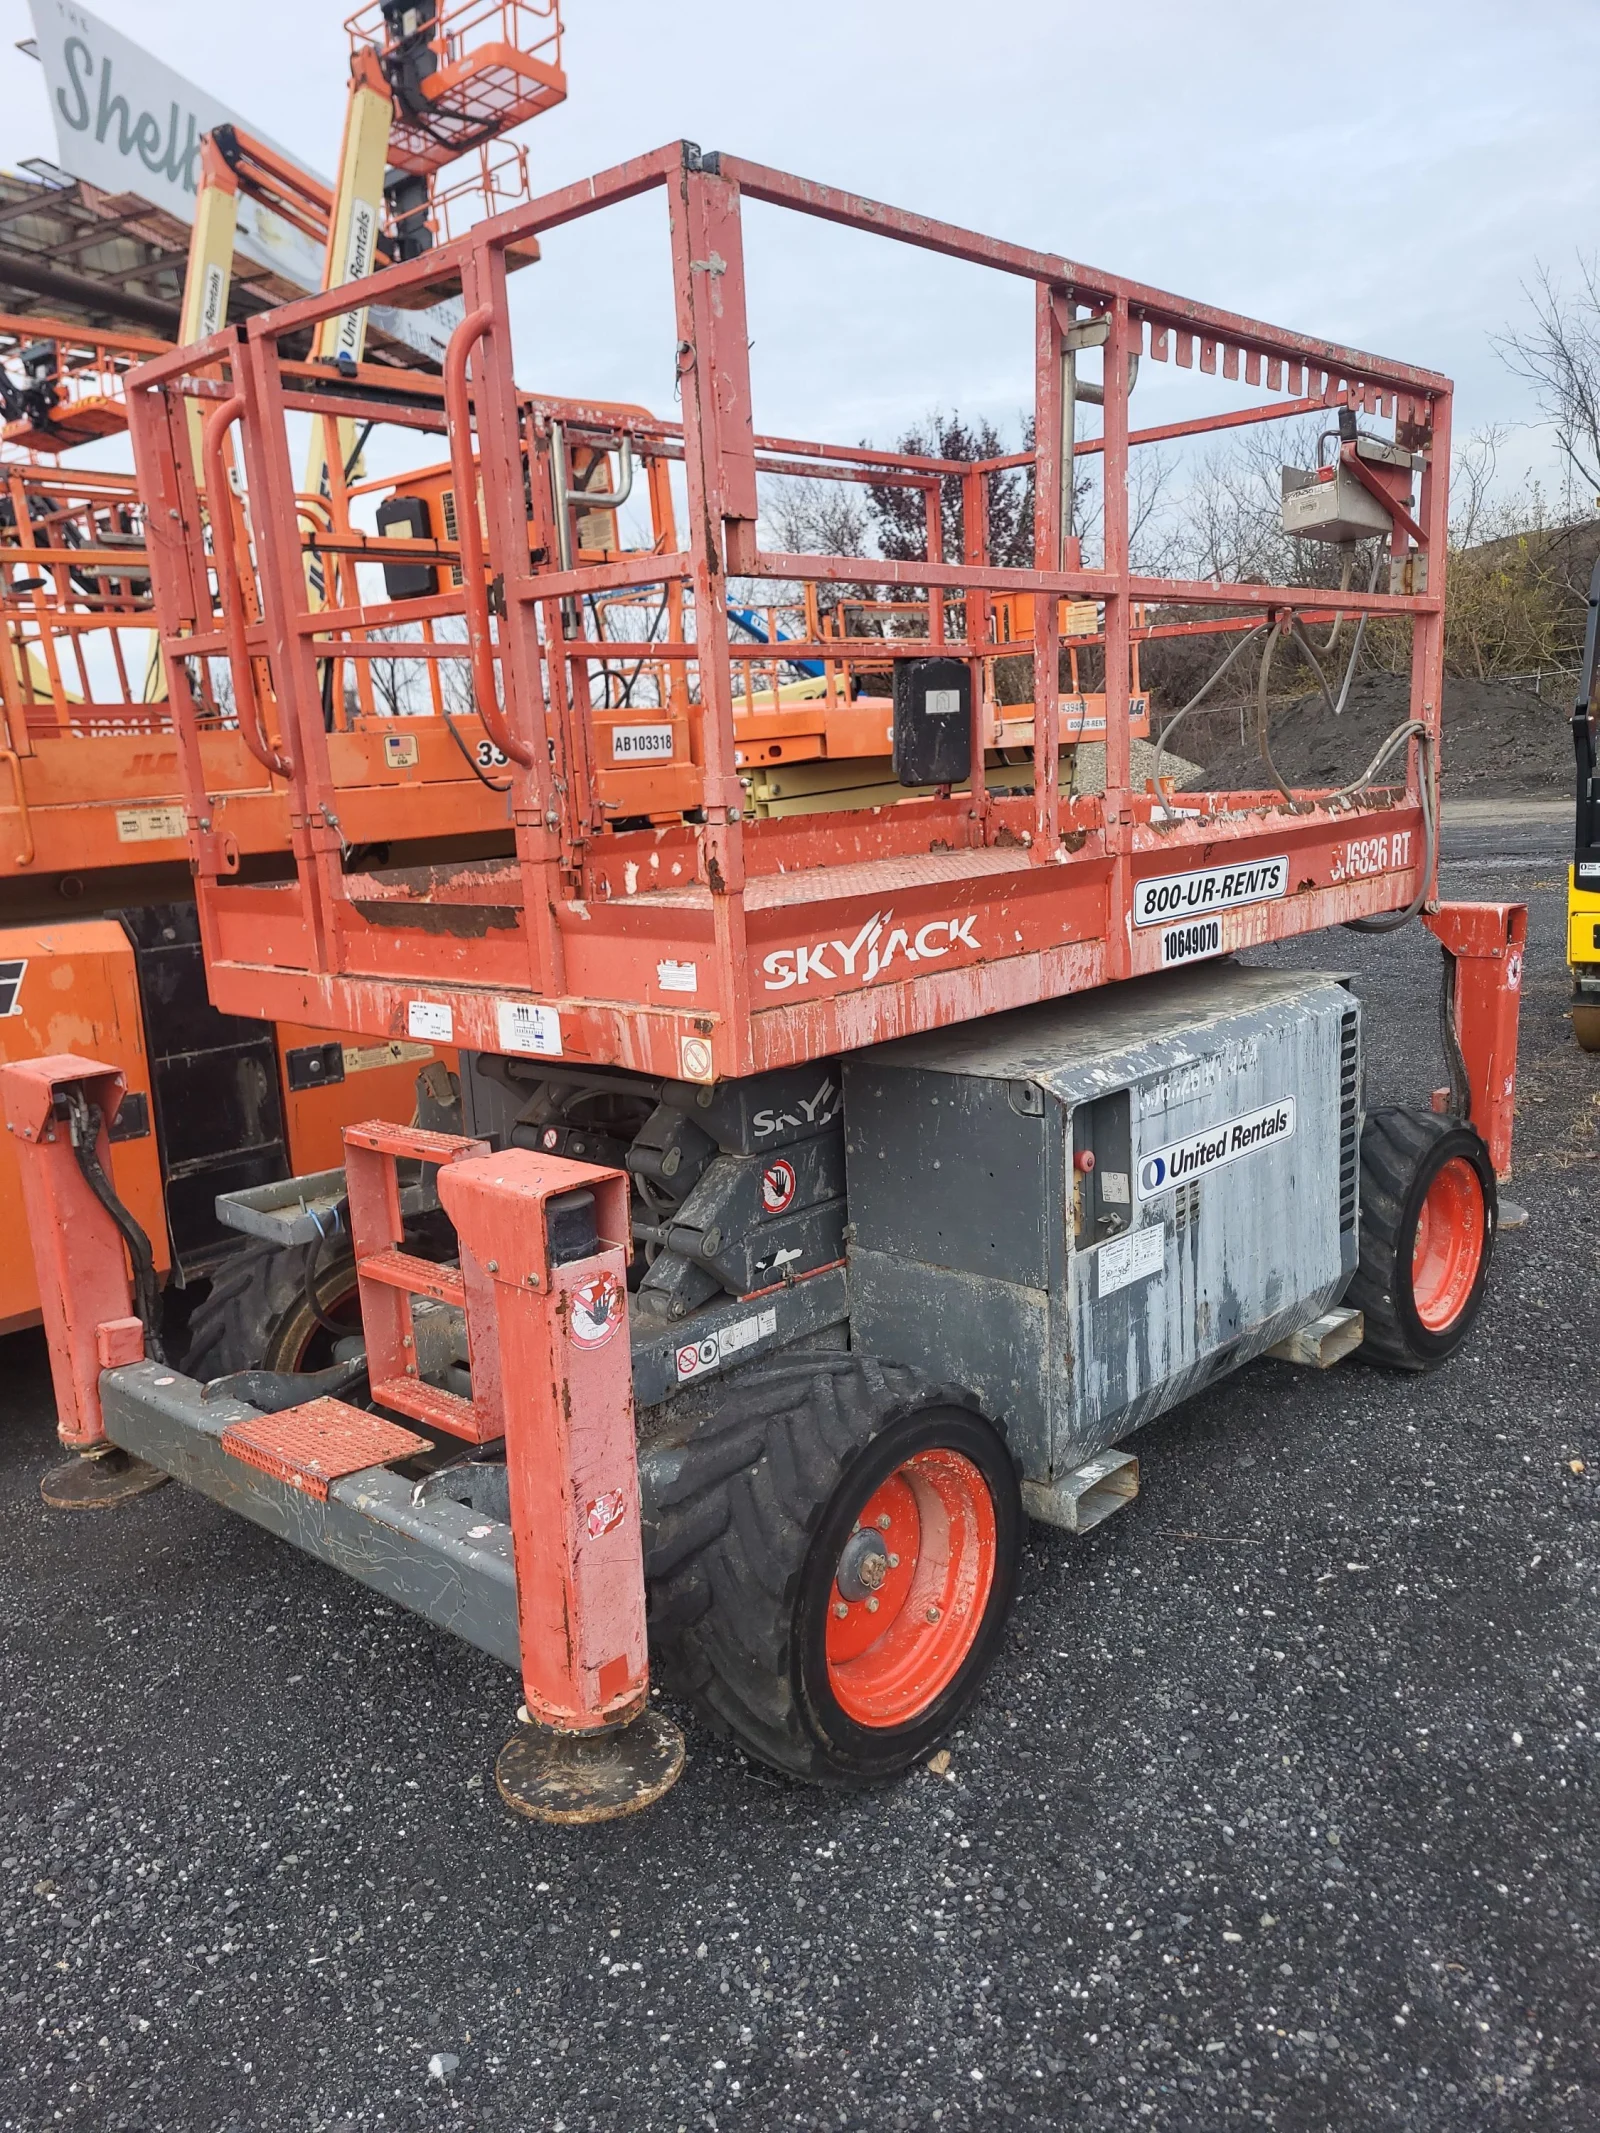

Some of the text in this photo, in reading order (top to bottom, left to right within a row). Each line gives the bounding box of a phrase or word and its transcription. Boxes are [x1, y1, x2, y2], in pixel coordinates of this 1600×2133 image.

[615, 734, 672, 752] AB103318
[1391, 831, 1412, 867] RT
[1144, 864, 1282, 915] 800-UR-RENTS
[762, 907, 982, 991] SKYJACK
[1164, 921, 1219, 962] 10649070
[1170, 1109, 1287, 1178] United Rentals
